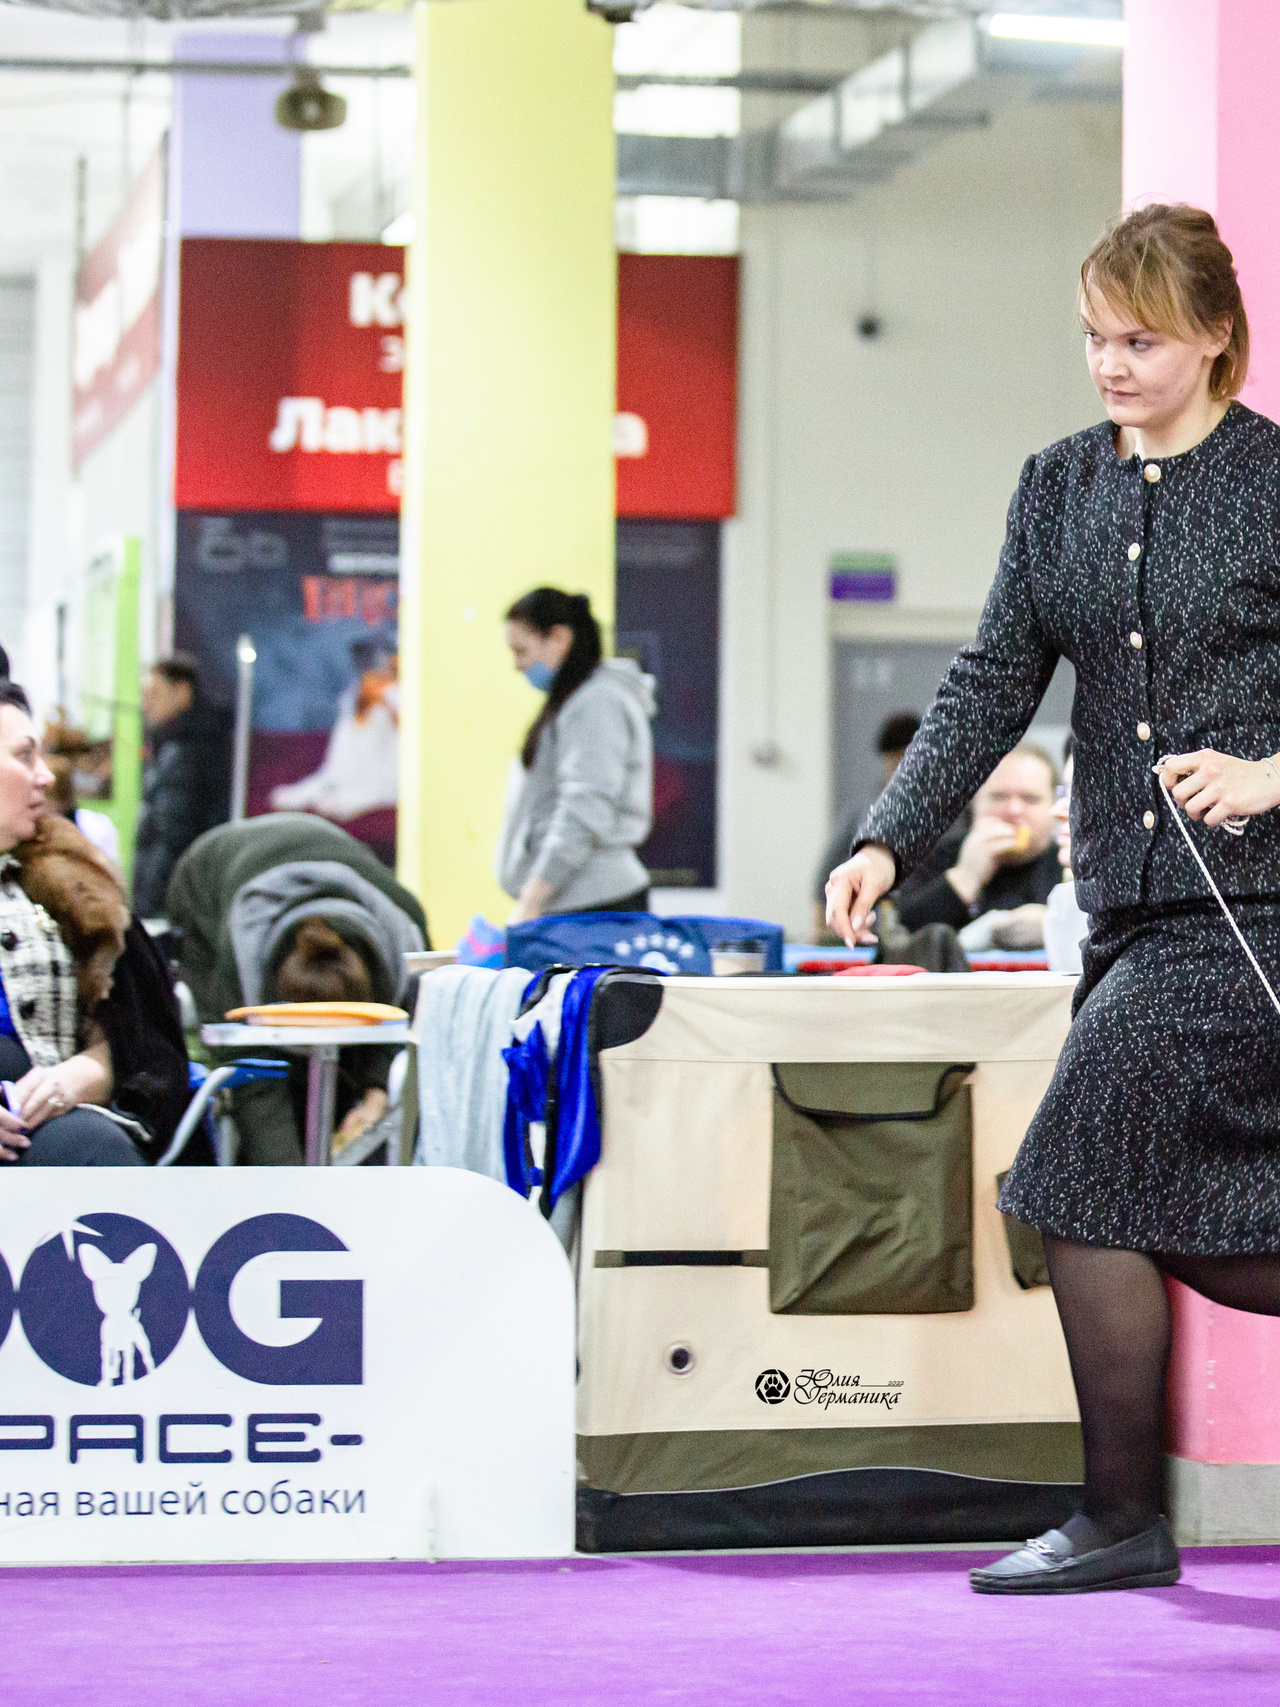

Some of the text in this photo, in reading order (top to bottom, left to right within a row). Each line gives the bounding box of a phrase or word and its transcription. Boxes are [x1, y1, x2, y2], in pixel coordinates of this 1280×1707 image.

[0, 1212, 364, 1387] OG
[76, 1482, 206, 1517] вашей
[221, 1479, 366, 1516] собаки
